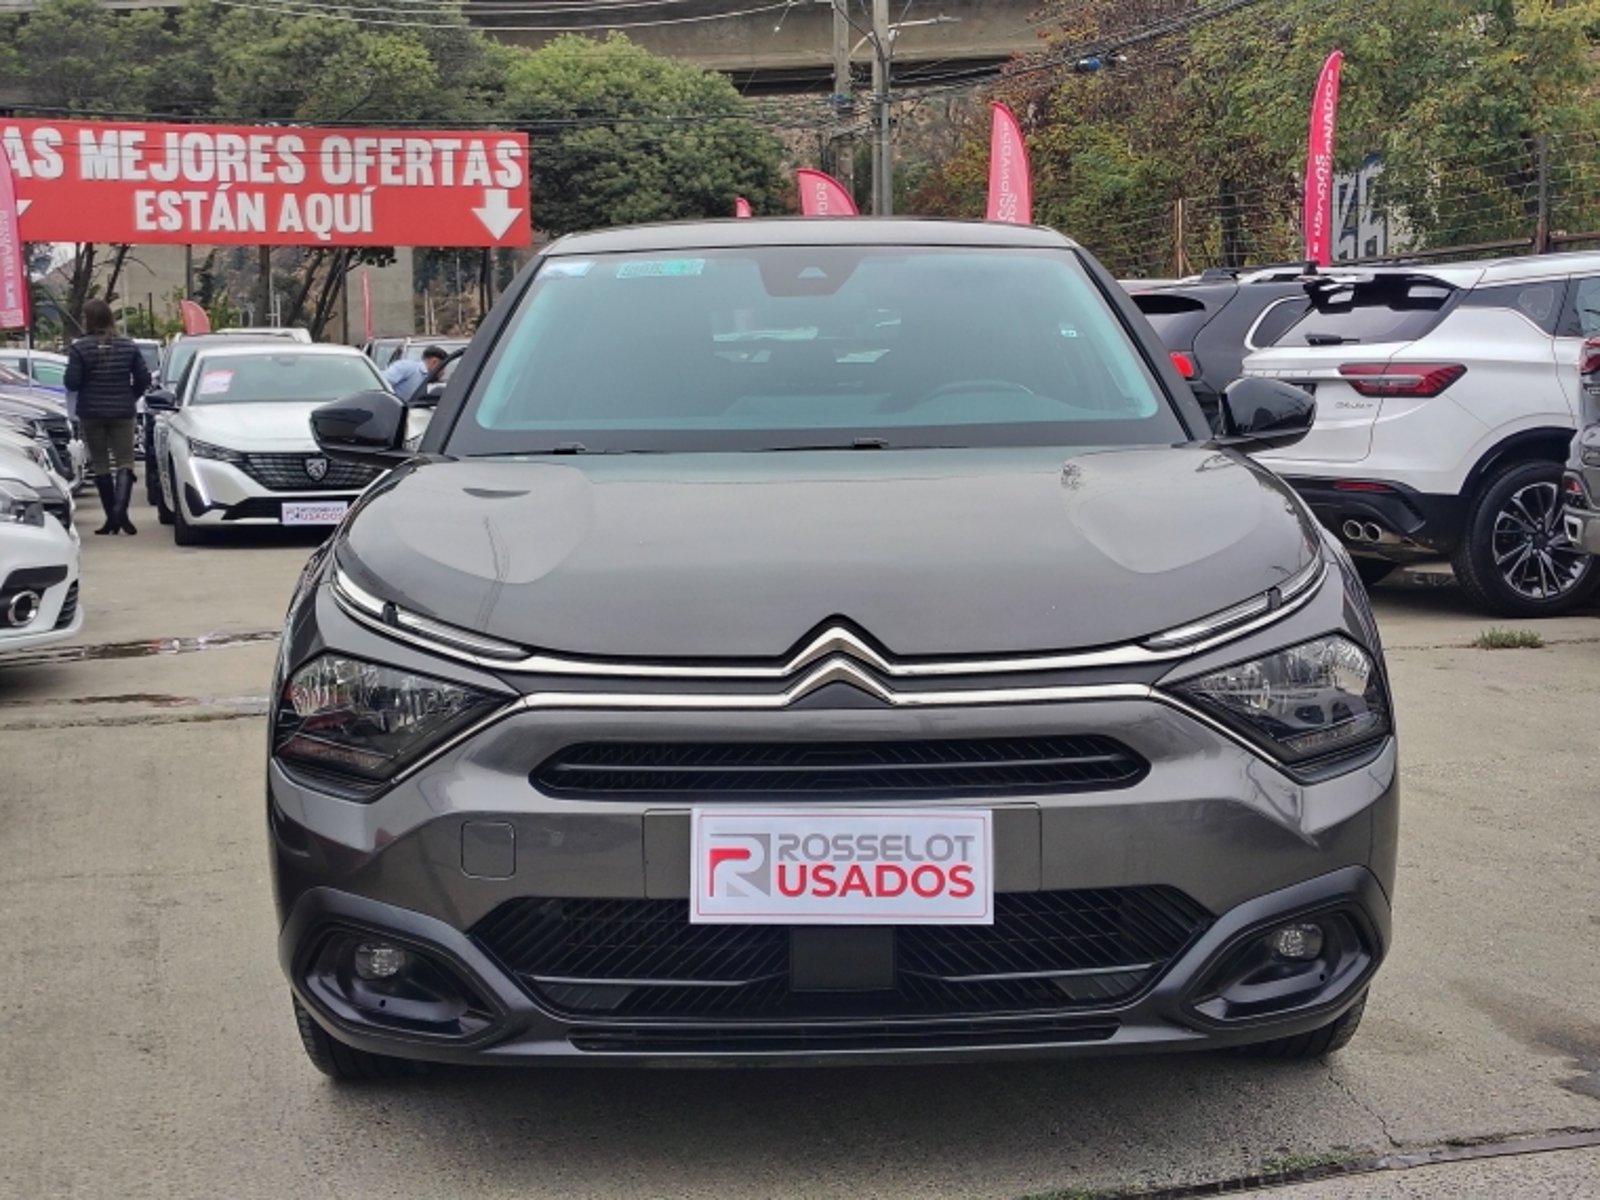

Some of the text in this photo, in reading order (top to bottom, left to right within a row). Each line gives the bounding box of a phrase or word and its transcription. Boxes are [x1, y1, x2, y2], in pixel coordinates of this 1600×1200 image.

[79, 129, 306, 185] MEJORES
[320, 134, 524, 188] OFERTAS
[135, 183, 377, 240] ESTÁN AQUÍ
[778, 834, 975, 861] ROSSELOT
[777, 864, 975, 898] USADOS
